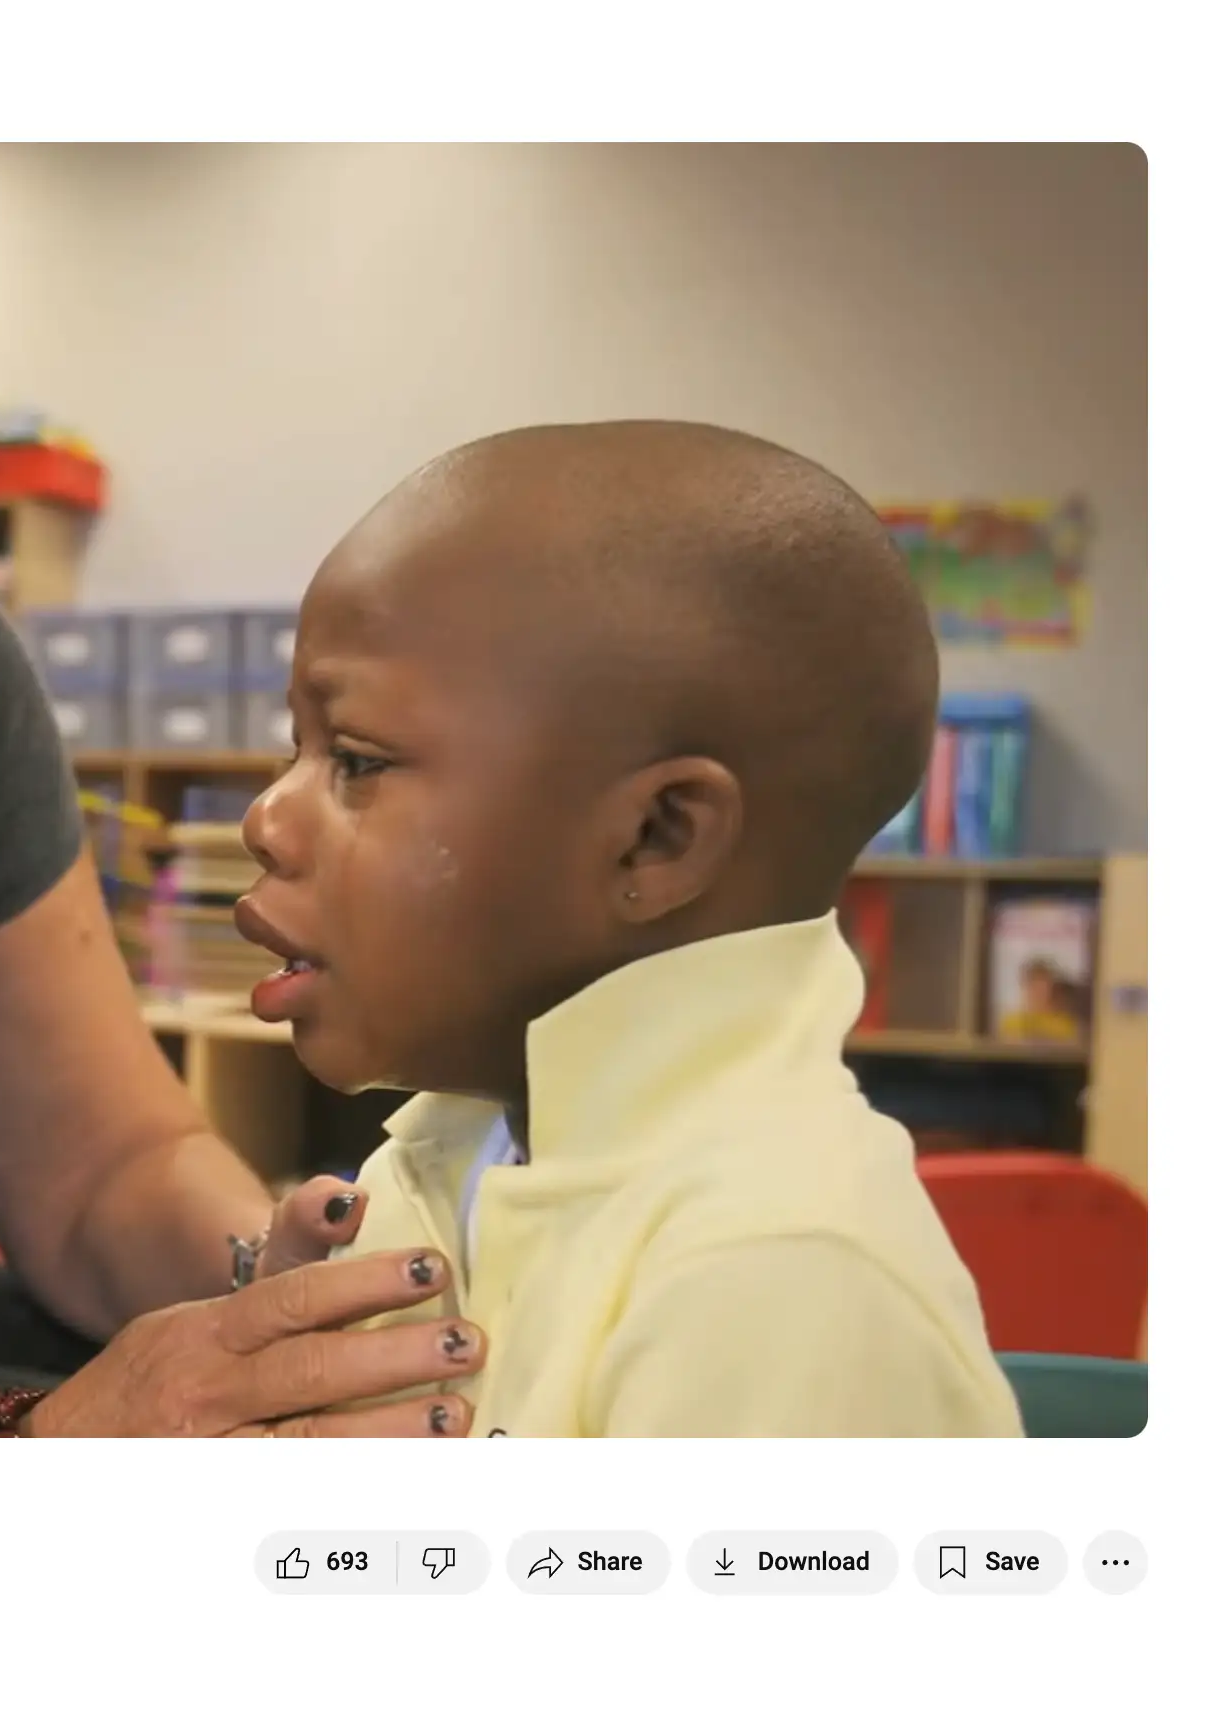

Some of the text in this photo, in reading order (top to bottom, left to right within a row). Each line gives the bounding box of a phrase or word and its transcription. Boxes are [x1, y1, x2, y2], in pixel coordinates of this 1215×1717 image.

[326, 1550, 369, 1572] 693
[577, 1549, 643, 1571] Share
[758, 1550, 870, 1572] Download
[985, 1550, 1040, 1572] Save
